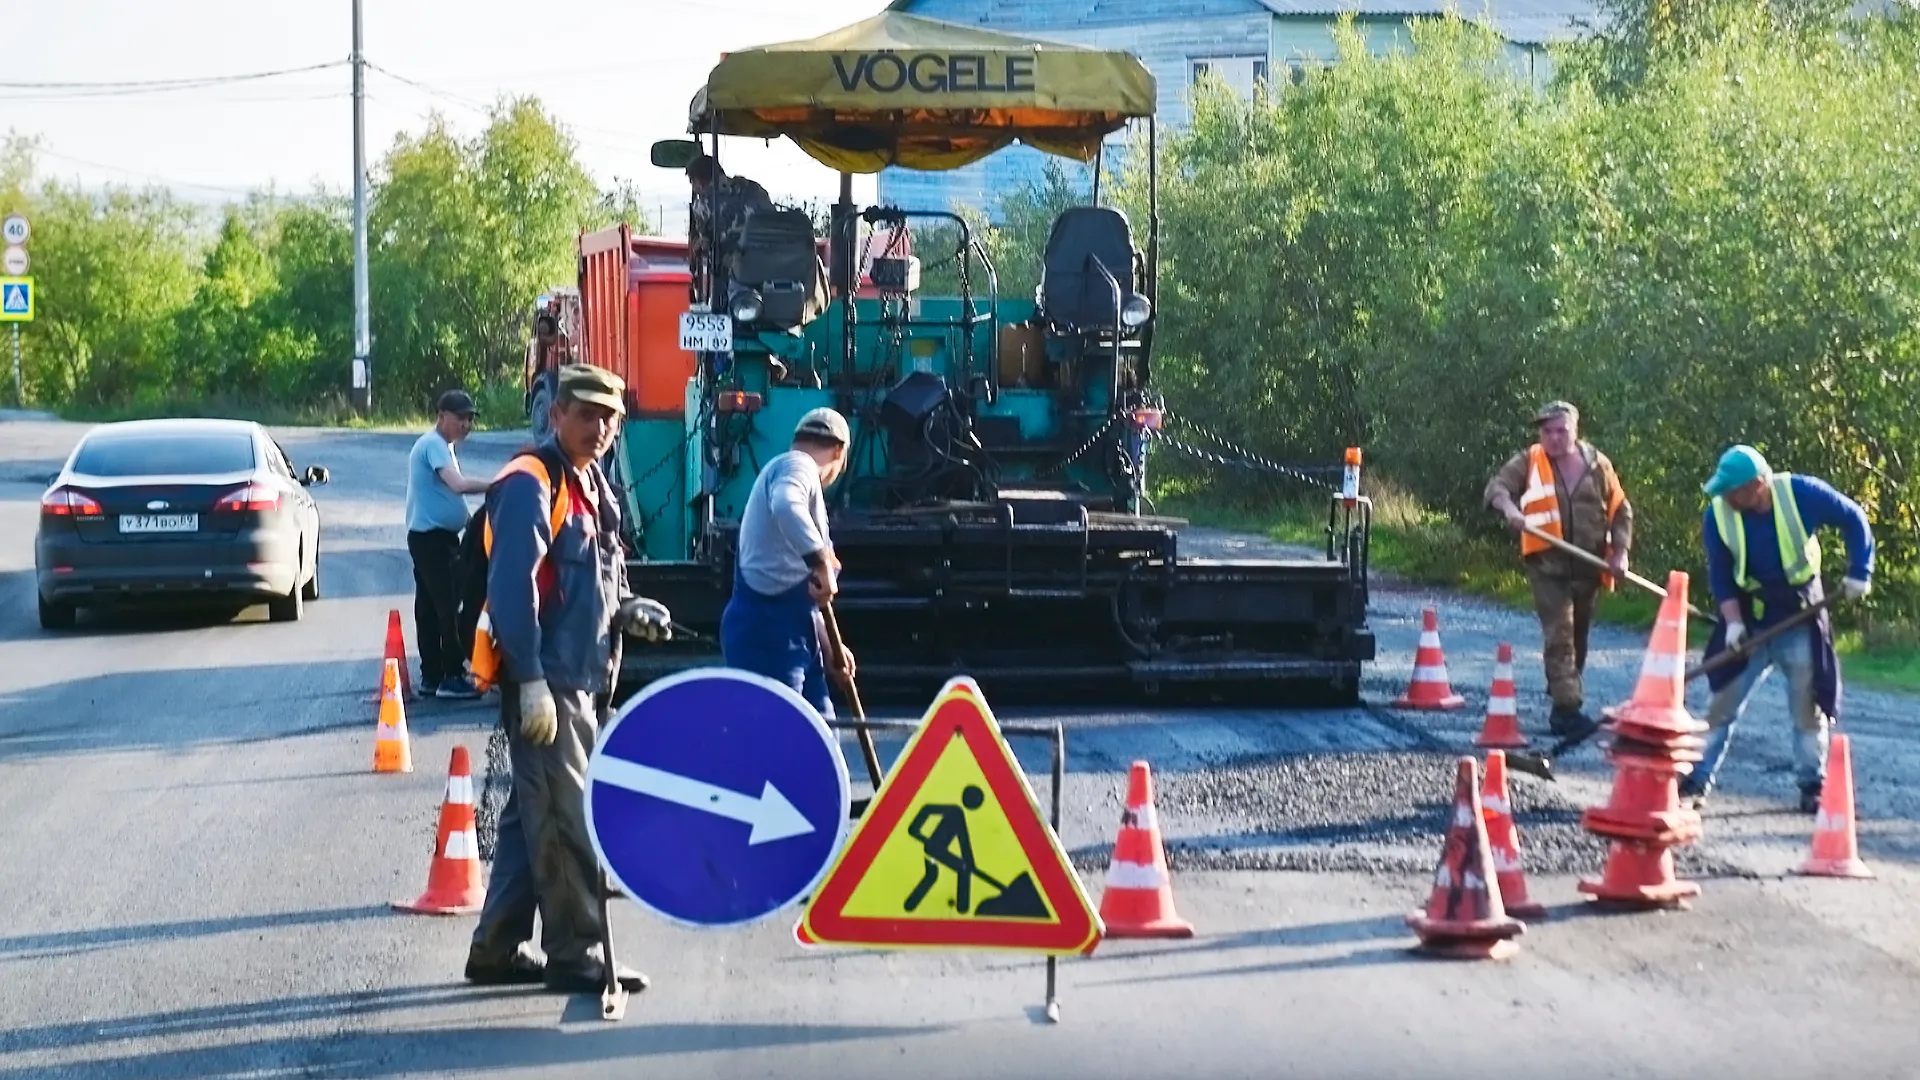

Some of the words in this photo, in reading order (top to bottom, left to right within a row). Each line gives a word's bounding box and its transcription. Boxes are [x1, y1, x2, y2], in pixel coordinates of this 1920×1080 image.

[831, 49, 1036, 93] VÖGELE
[8, 224, 24, 236] 40
[686, 315, 726, 331] 9553
